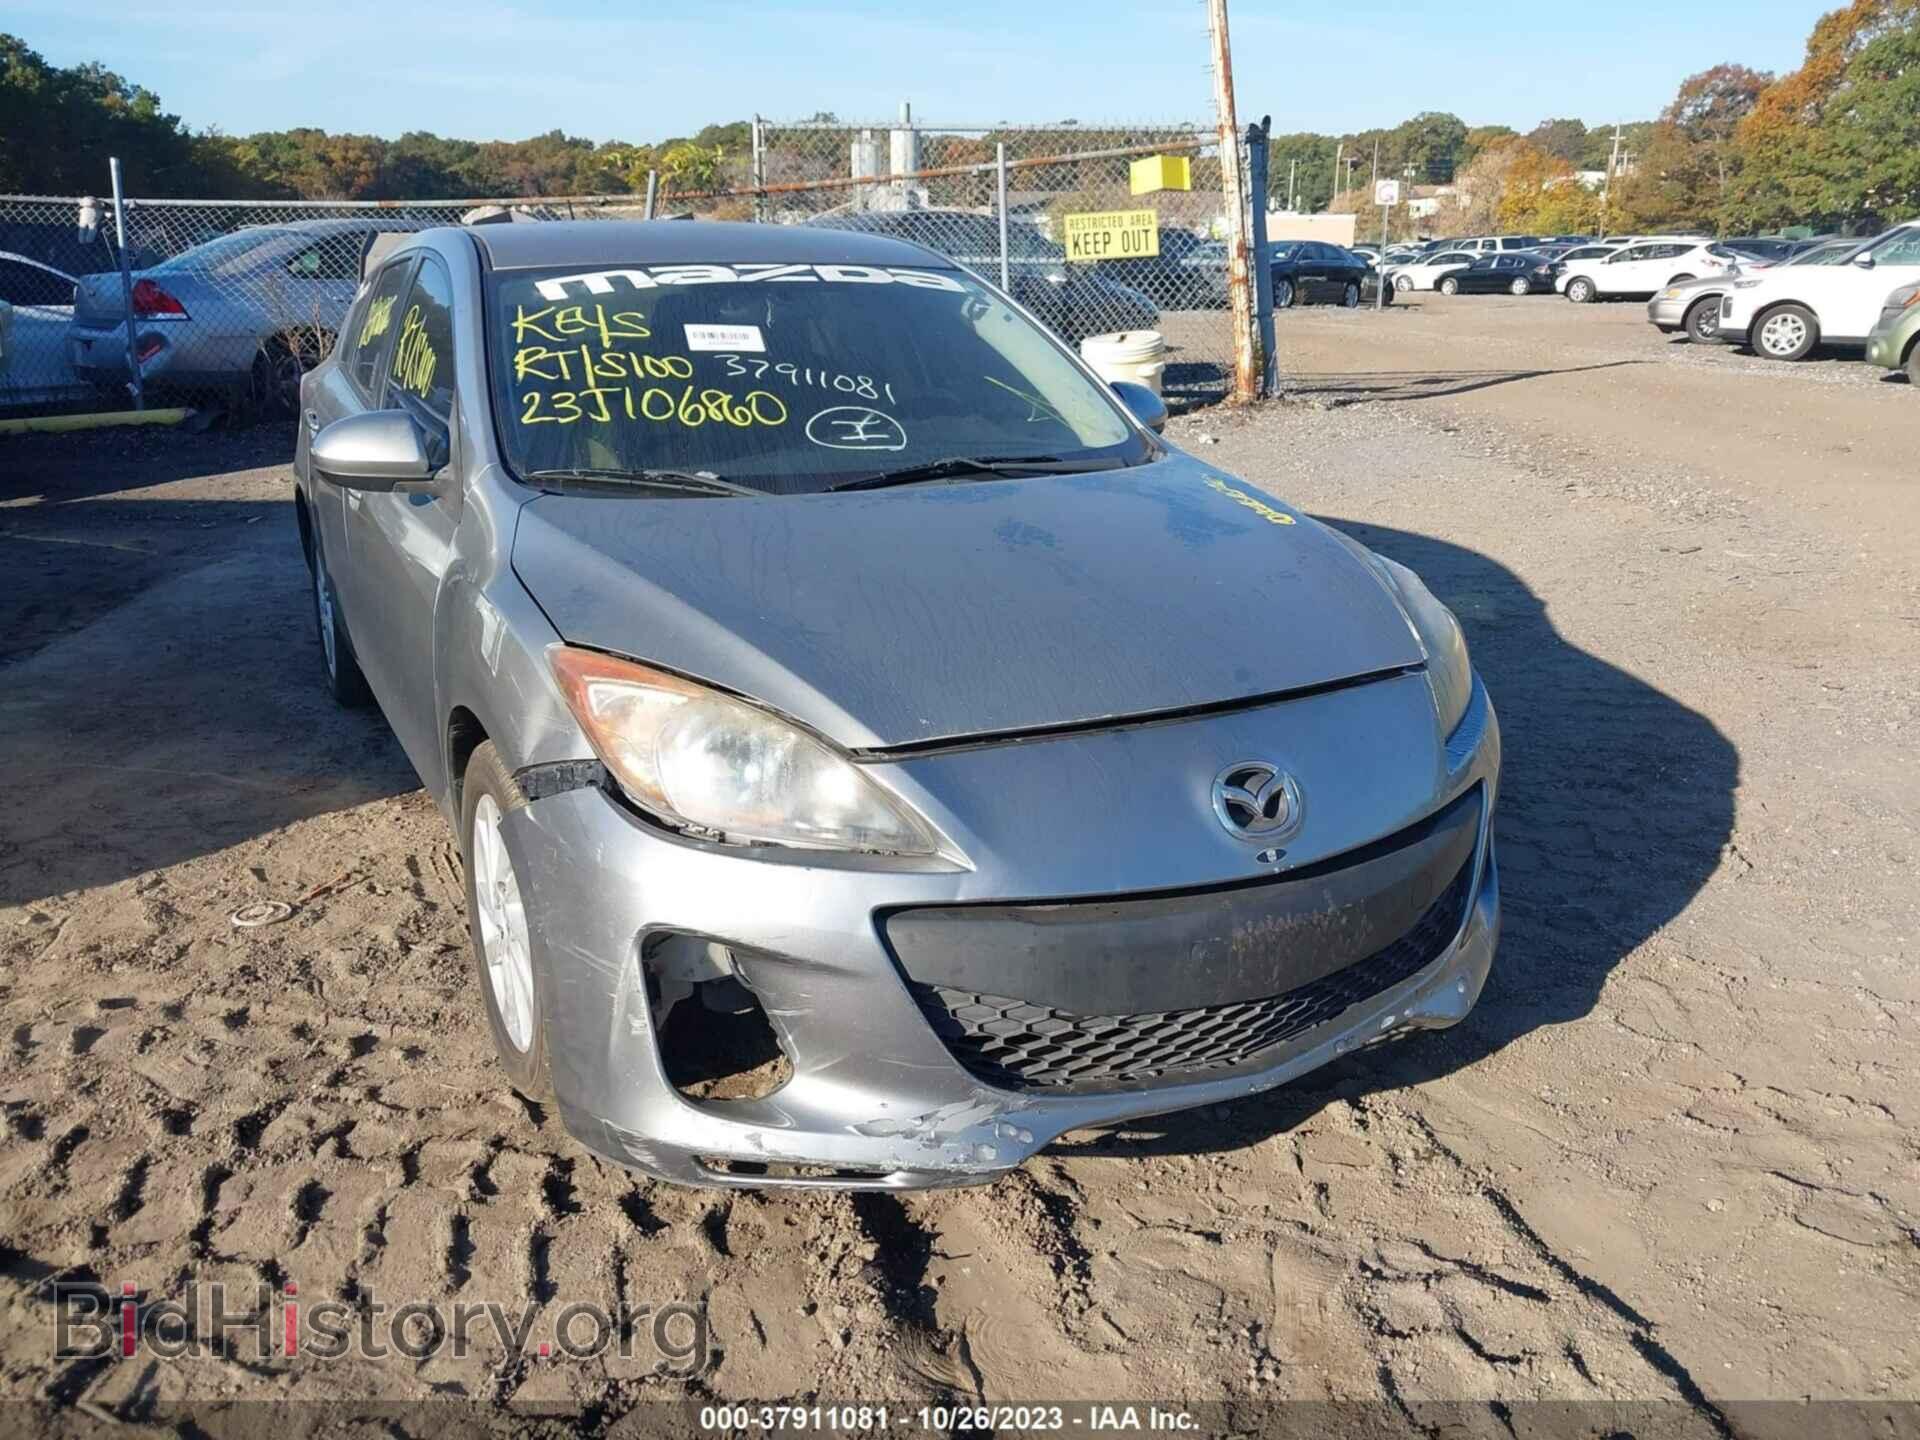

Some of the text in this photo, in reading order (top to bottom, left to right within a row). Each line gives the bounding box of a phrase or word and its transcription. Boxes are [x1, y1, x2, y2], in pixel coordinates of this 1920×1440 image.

[1072, 229, 1150, 256] KEEP OUT
[713, 354, 896, 405] 37911081
